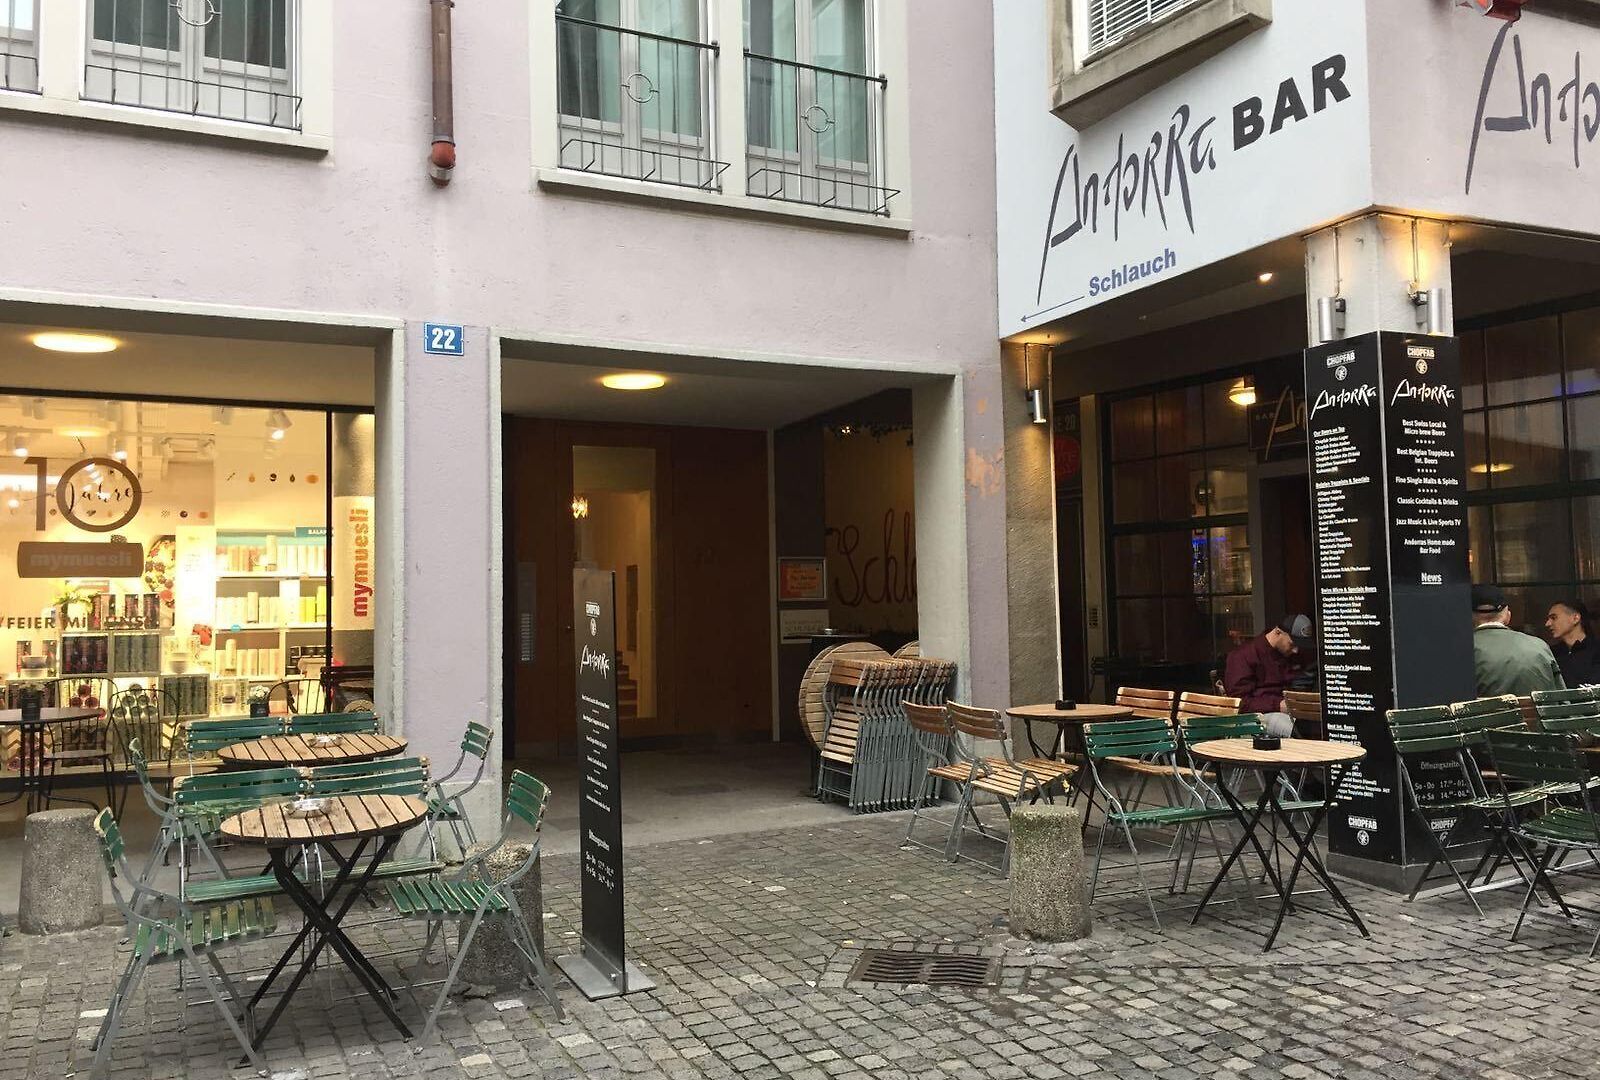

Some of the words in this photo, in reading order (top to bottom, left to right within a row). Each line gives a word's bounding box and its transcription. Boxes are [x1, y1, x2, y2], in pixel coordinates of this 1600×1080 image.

[1233, 53, 1351, 151] BAR
[1089, 248, 1176, 297] Schlauch
[432, 328, 455, 349] 22
[1407, 348, 1435, 358] CHOPFAB
[1327, 352, 1356, 366] CHOPFAB
[1409, 448, 1427, 457] Belgian
[1427, 449, 1450, 458] Trappists
[1407, 477, 1423, 485] Single
[1442, 478, 1459, 486] Spirits
[1397, 497, 1415, 505] Classic
[1443, 498, 1459, 506] Drinks
[1396, 518, 1407, 526] Jazz
[1439, 519, 1455, 527] Sports
[30, 551, 132, 570] mymuesli
[349, 508, 374, 617] mymuesli
[1421, 573, 1442, 582] News
[8, 617, 55, 629] FEIER
[1420, 761, 1460, 770] Öffnungszeite
[1348, 817, 1378, 830] CHOPFAB
[1431, 819, 1457, 830] CHOPFA
